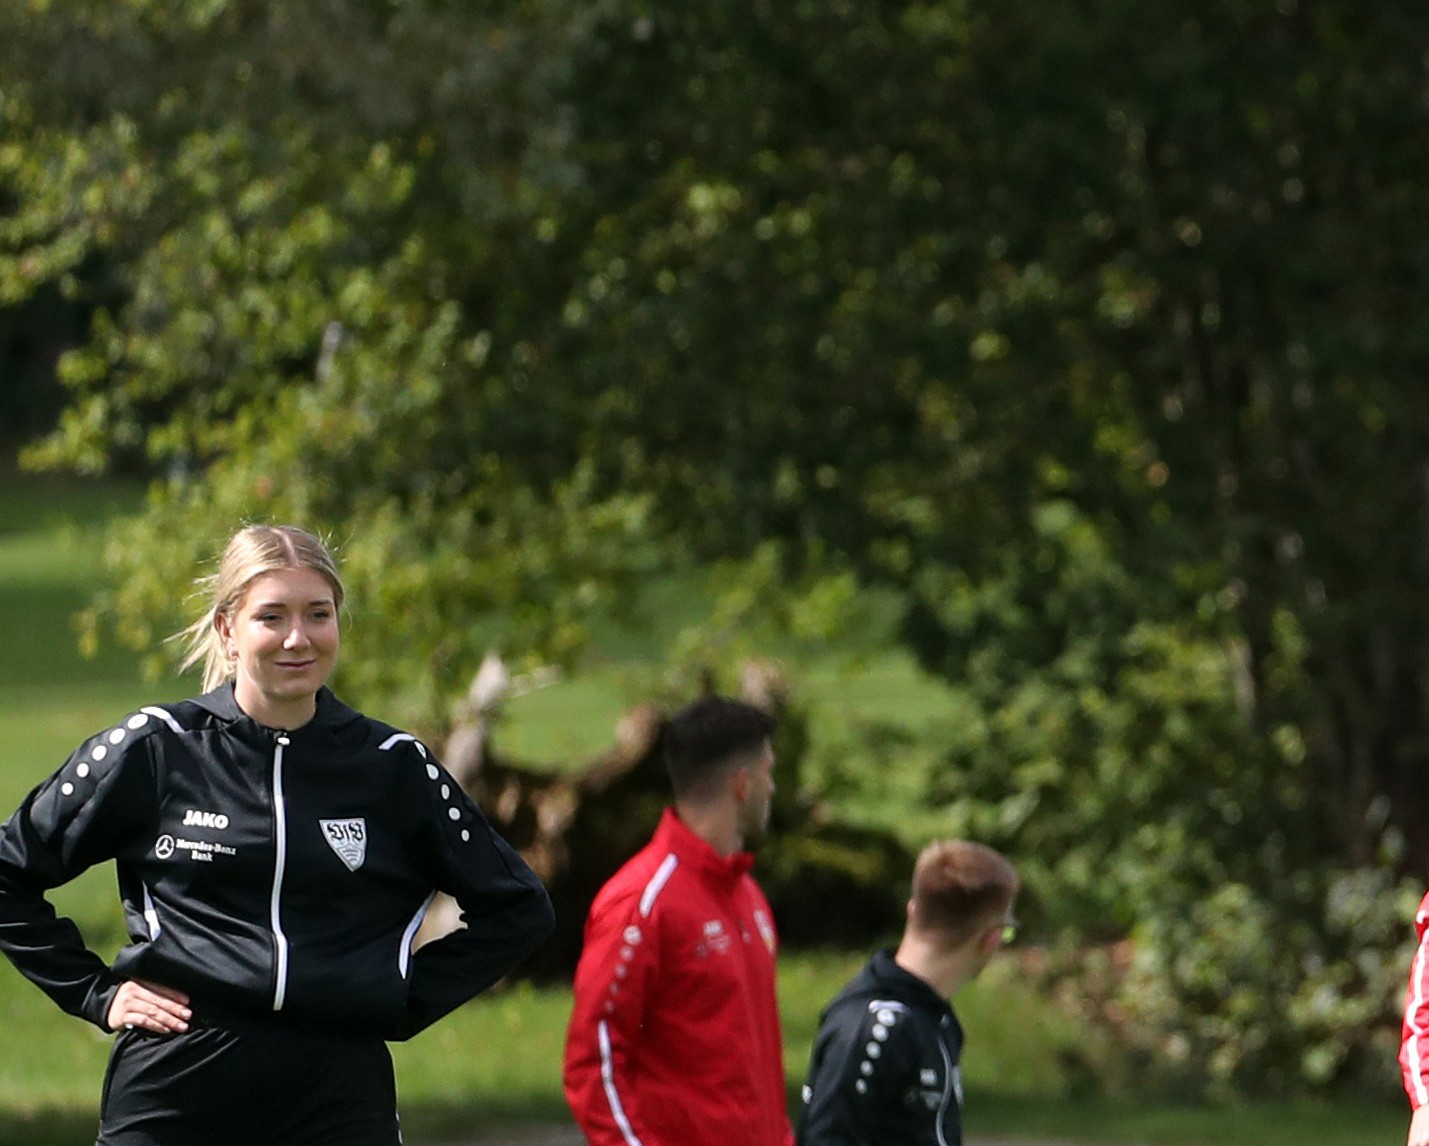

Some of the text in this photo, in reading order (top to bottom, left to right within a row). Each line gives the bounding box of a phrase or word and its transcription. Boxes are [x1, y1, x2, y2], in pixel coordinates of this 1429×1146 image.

[182, 809, 229, 829] JAKO
[176, 839, 236, 856] Mercedes-Benz
[191, 851, 213, 862] Bank
